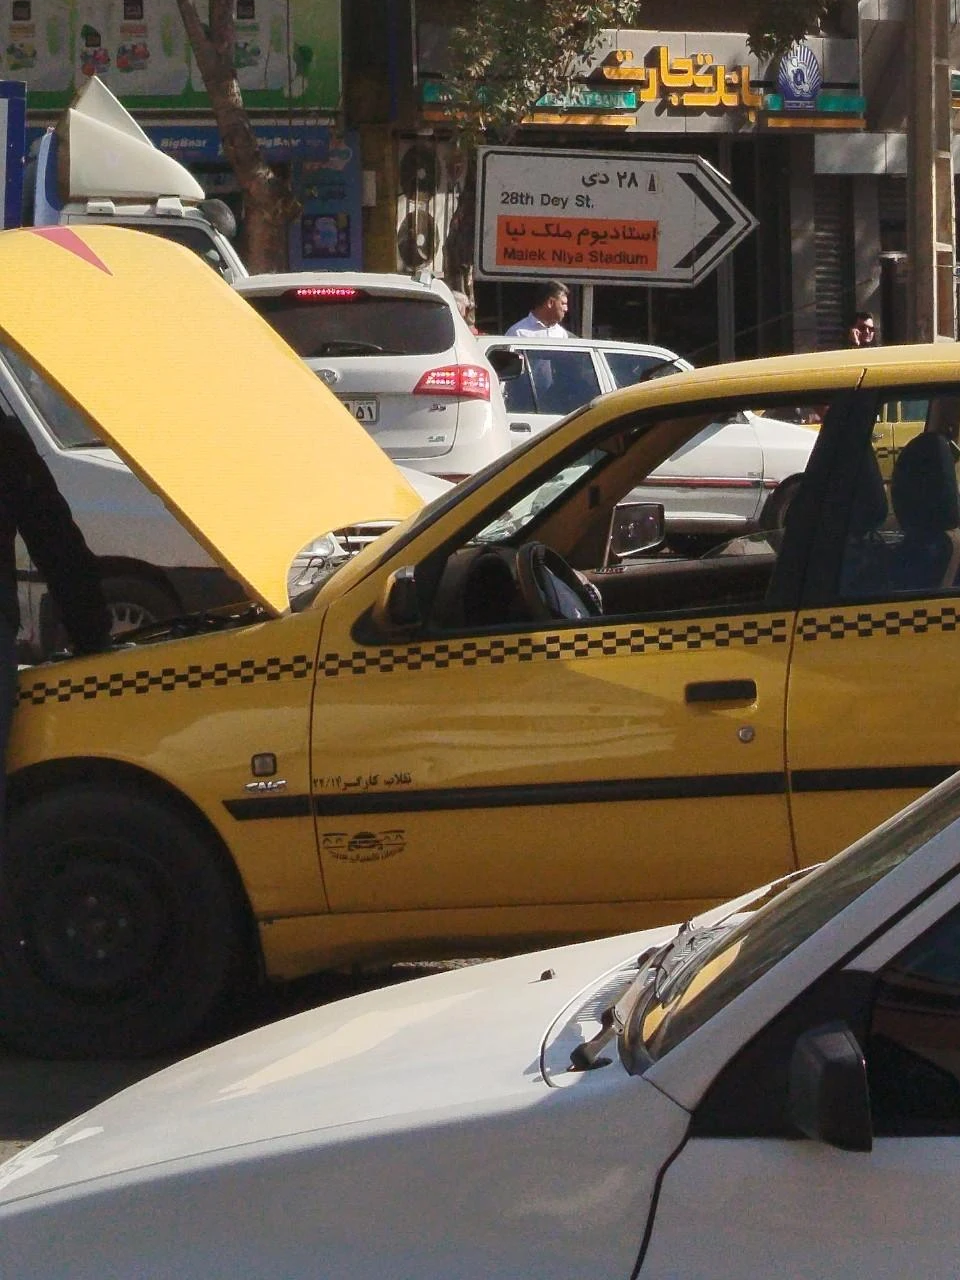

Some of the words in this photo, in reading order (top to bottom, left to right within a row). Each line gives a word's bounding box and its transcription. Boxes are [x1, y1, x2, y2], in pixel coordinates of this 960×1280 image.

[581, 171, 610, 188] دی
[617, 171, 639, 188] ۲۸
[500, 191, 534, 206] 28th
[540, 193, 568, 209] Dey
[575, 194, 594, 209] St.
[505, 221, 526, 242] نیا
[531, 222, 572, 239] ملک
[576, 225, 657, 246] استادیوم
[503, 247, 545, 261] Malek
[551, 250, 584, 265] Niya
[588, 250, 648, 265] Stadium
[355, 405, 373, 420] ۵۱
